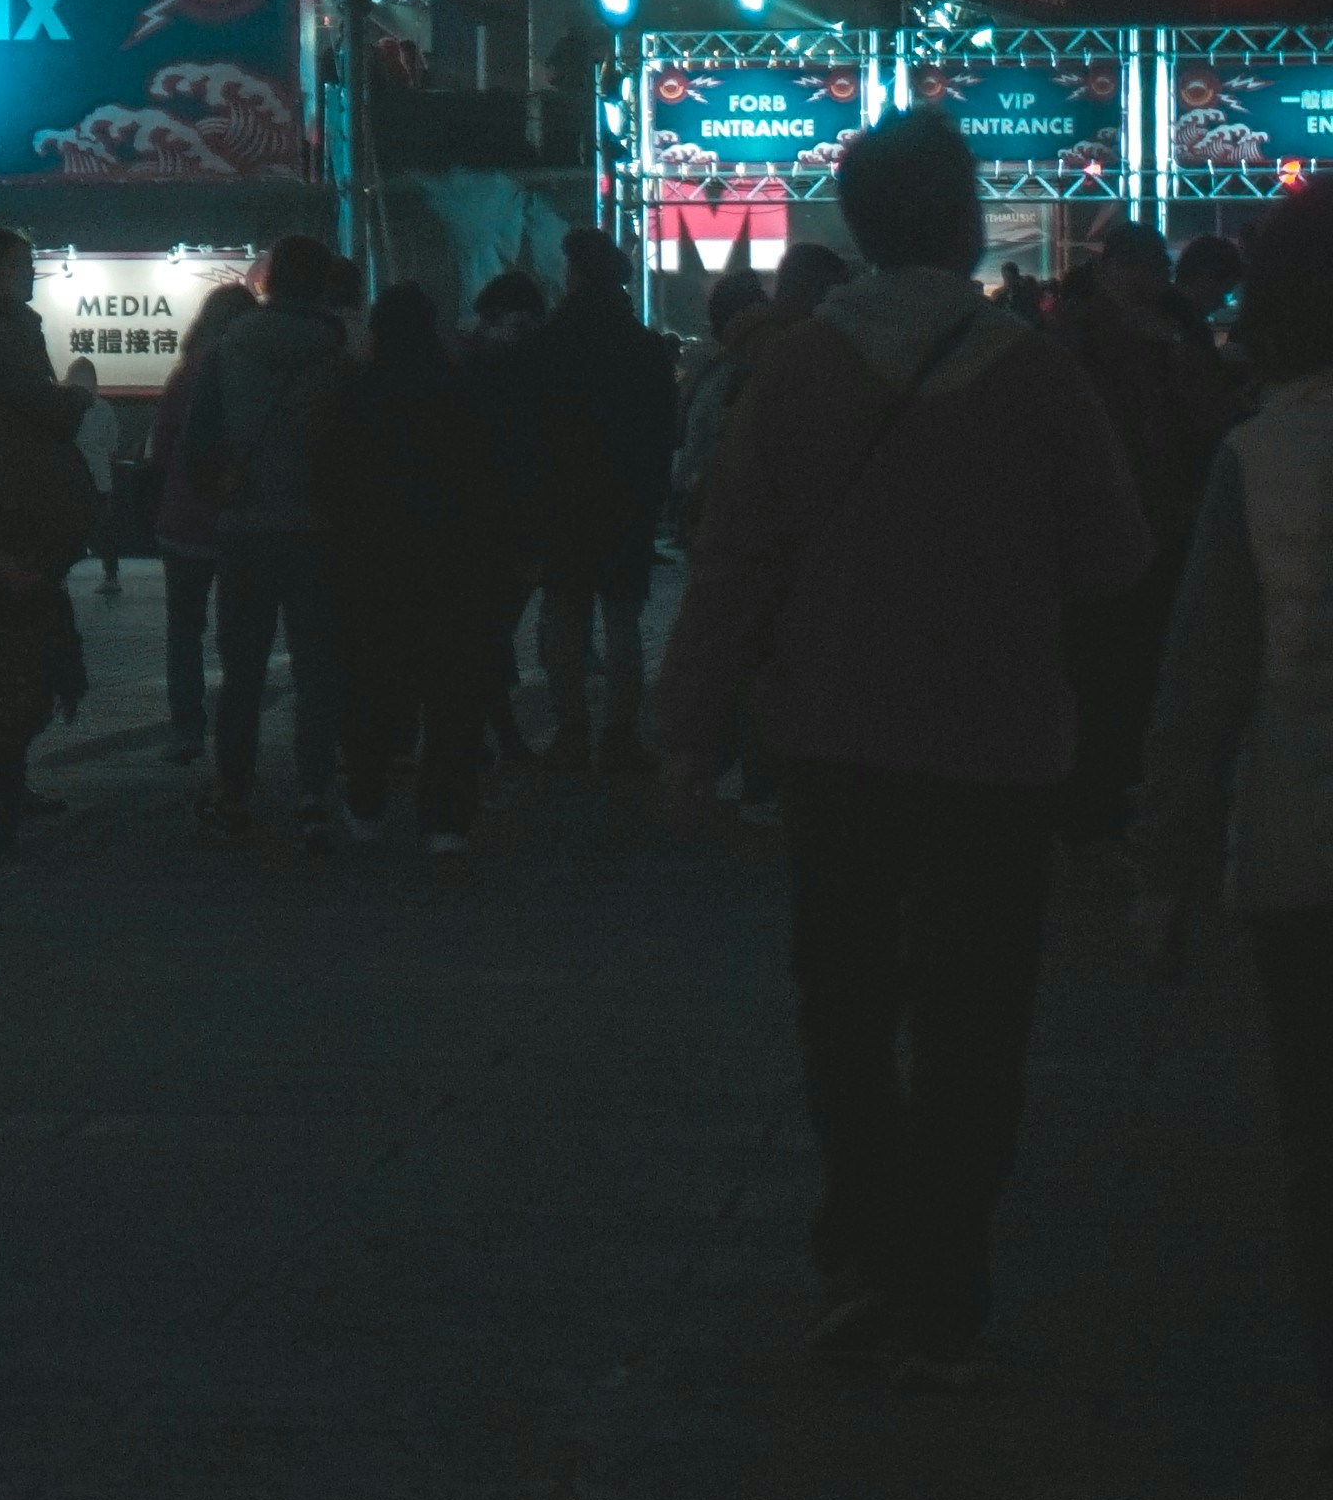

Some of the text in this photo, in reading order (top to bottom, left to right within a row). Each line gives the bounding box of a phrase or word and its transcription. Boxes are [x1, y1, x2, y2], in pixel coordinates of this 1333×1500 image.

[728, 94, 787, 112] FORB
[997, 92, 1036, 110] VIP
[700, 118, 815, 138] ENTRANCE
[959, 117, 1074, 135] ENTRANCE
[76, 295, 173, 317] MEDIA
[69, 328, 179, 354] 媒體接待
